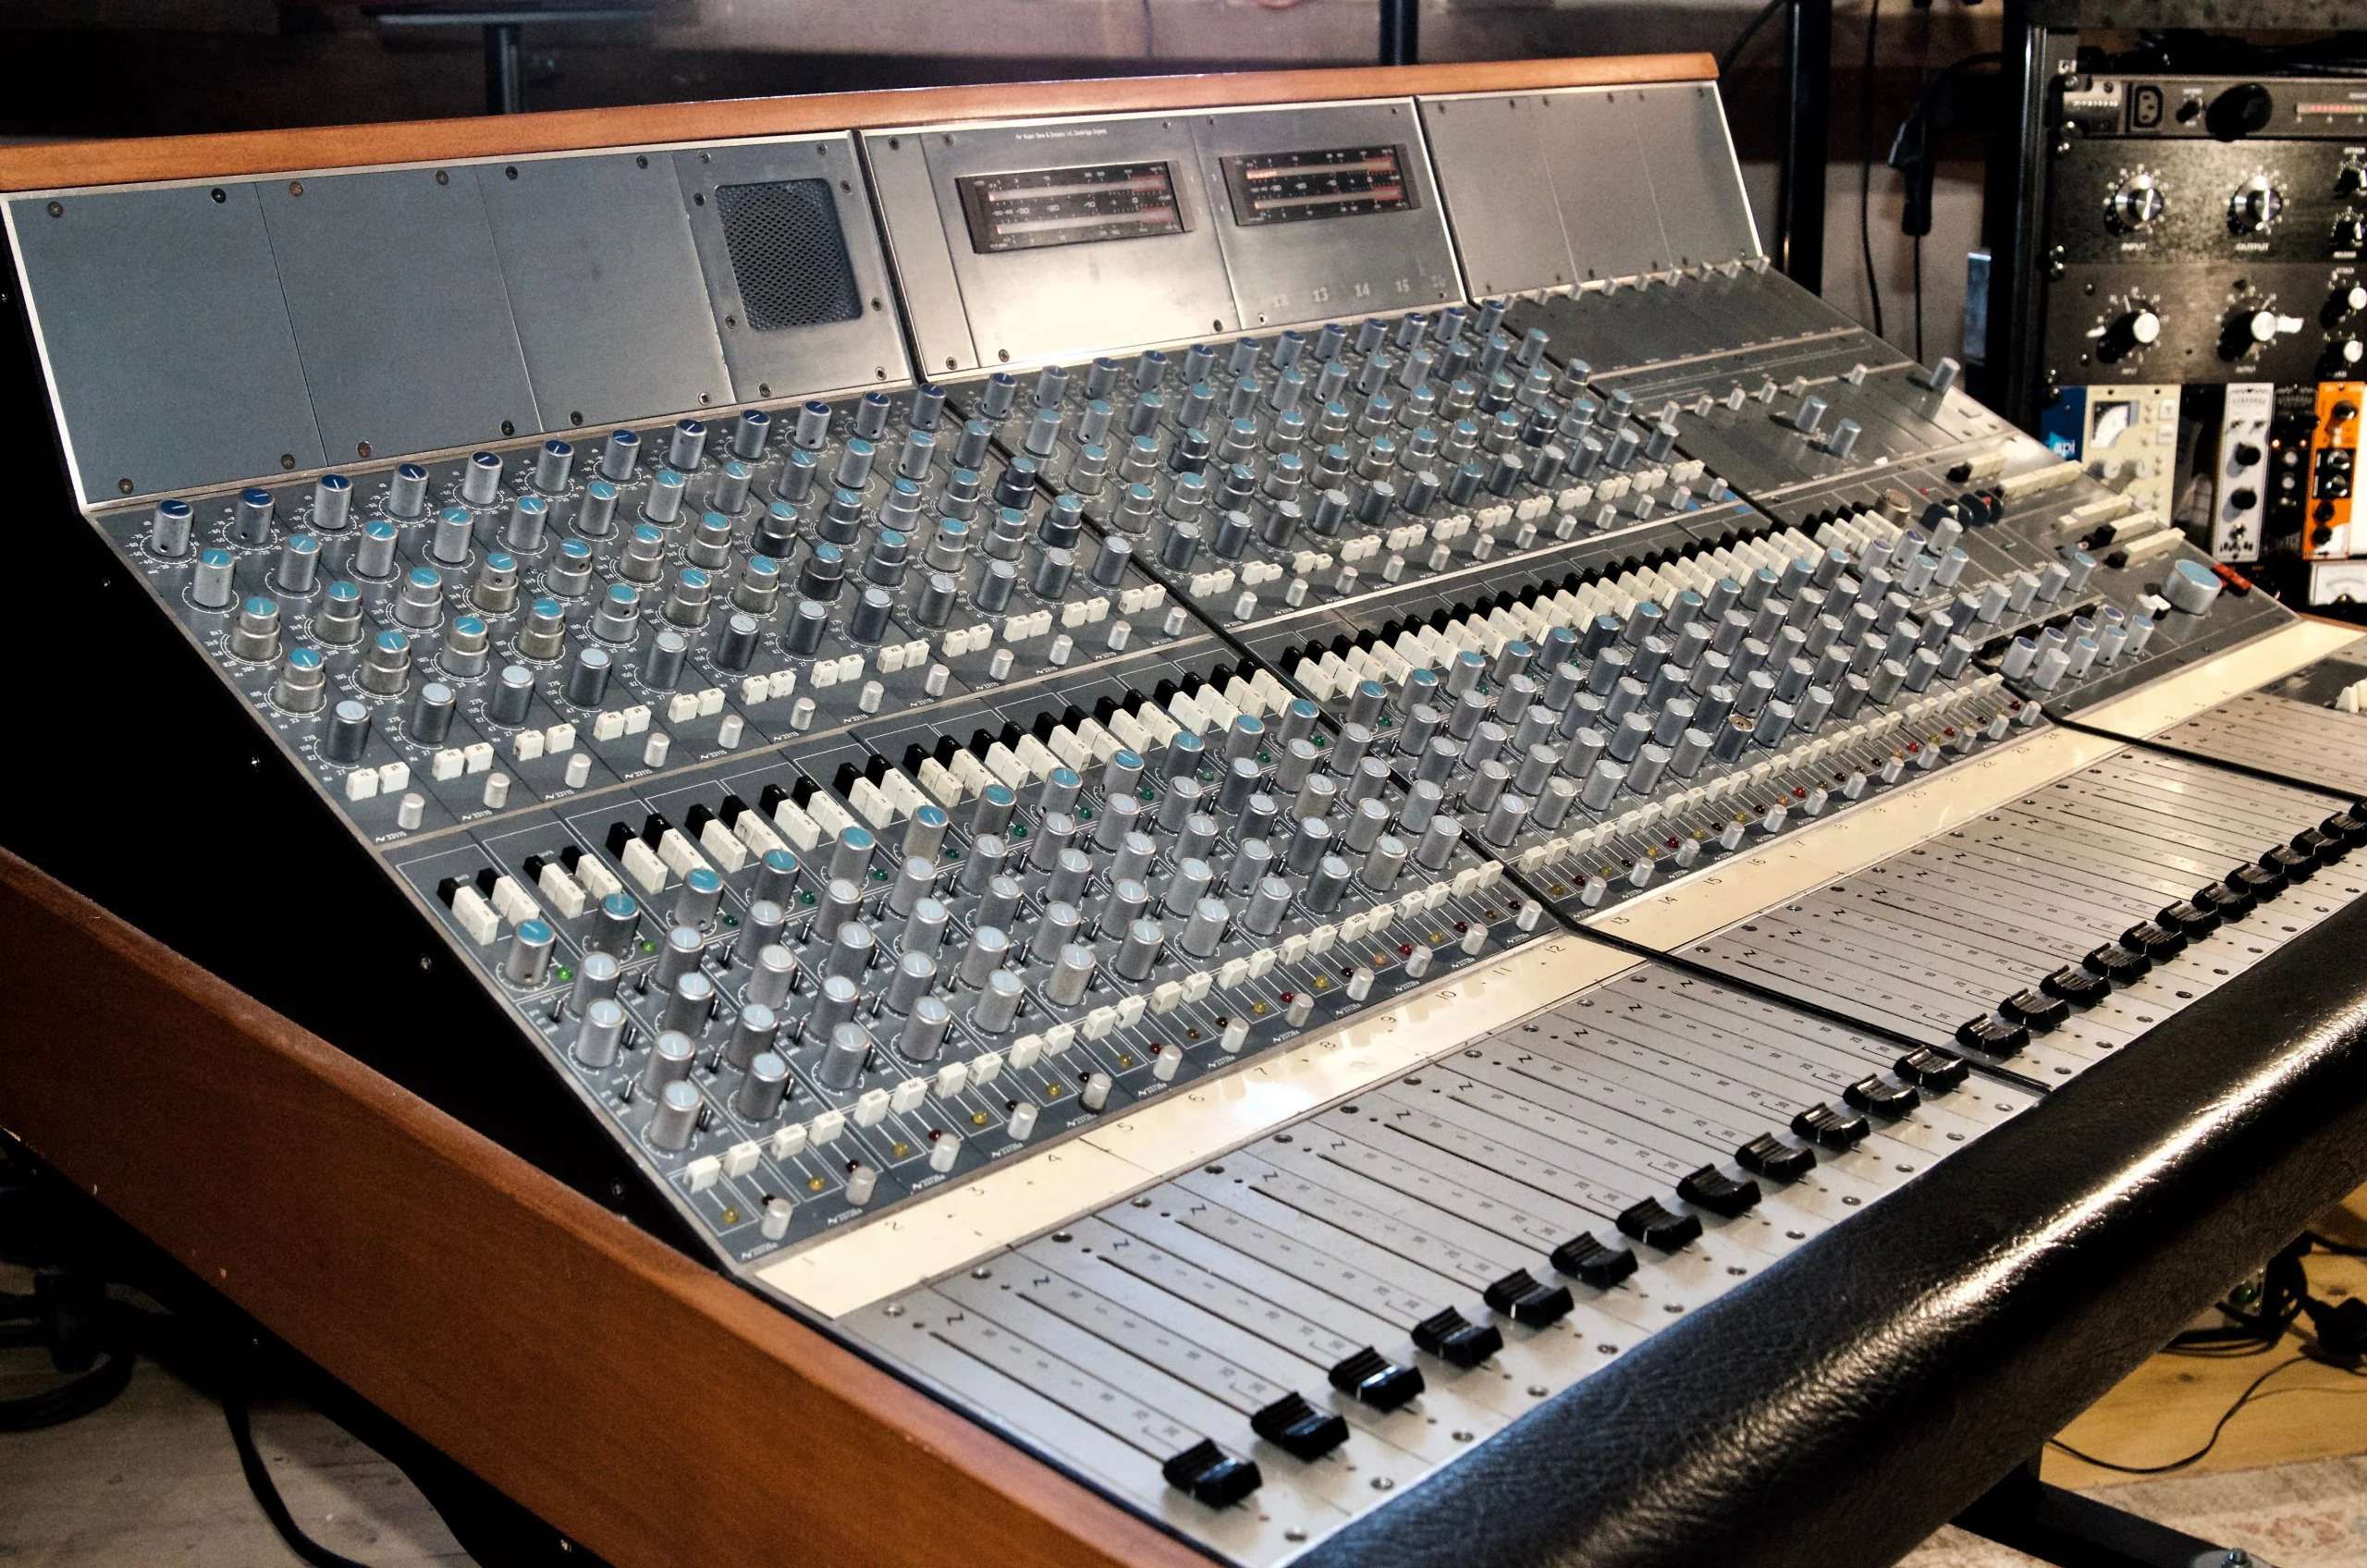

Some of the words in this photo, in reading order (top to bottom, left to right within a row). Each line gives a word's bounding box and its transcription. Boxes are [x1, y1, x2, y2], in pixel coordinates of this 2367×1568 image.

[1354, 282, 1370, 297] 14
[1747, 858, 1766, 866] 16
[1659, 896, 1678, 905] 14
[1611, 916, 1629, 925] 13
[1545, 945, 1566, 954] 12
[1493, 967, 1512, 976] 11
[1435, 990, 1457, 1000] 10
[1117, 1123, 1134, 1131] 5
[884, 1221, 903, 1231] 2
